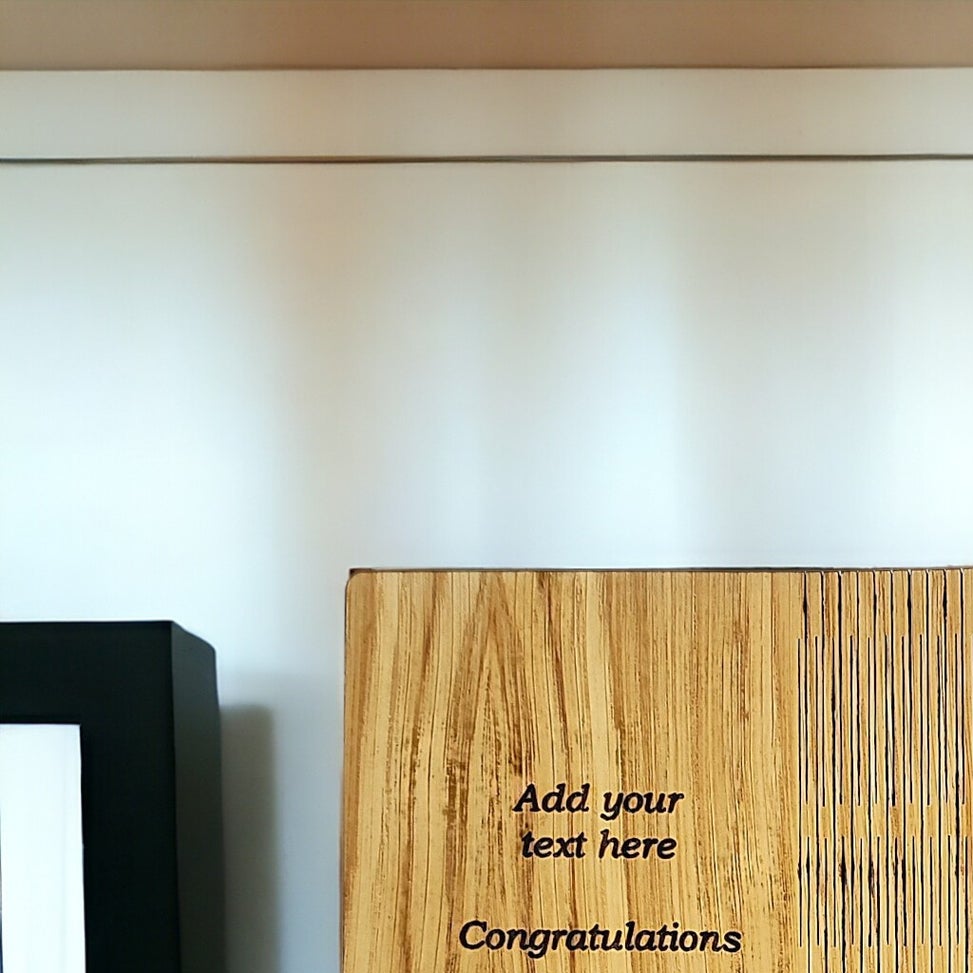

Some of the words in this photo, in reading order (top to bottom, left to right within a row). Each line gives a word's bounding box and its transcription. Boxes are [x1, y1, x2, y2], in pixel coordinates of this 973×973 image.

[512, 783, 590, 813] Add
[600, 790, 684, 821] your
[521, 830, 588, 859] text
[598, 829, 678, 859] here
[459, 920, 742, 959] Congratulations
